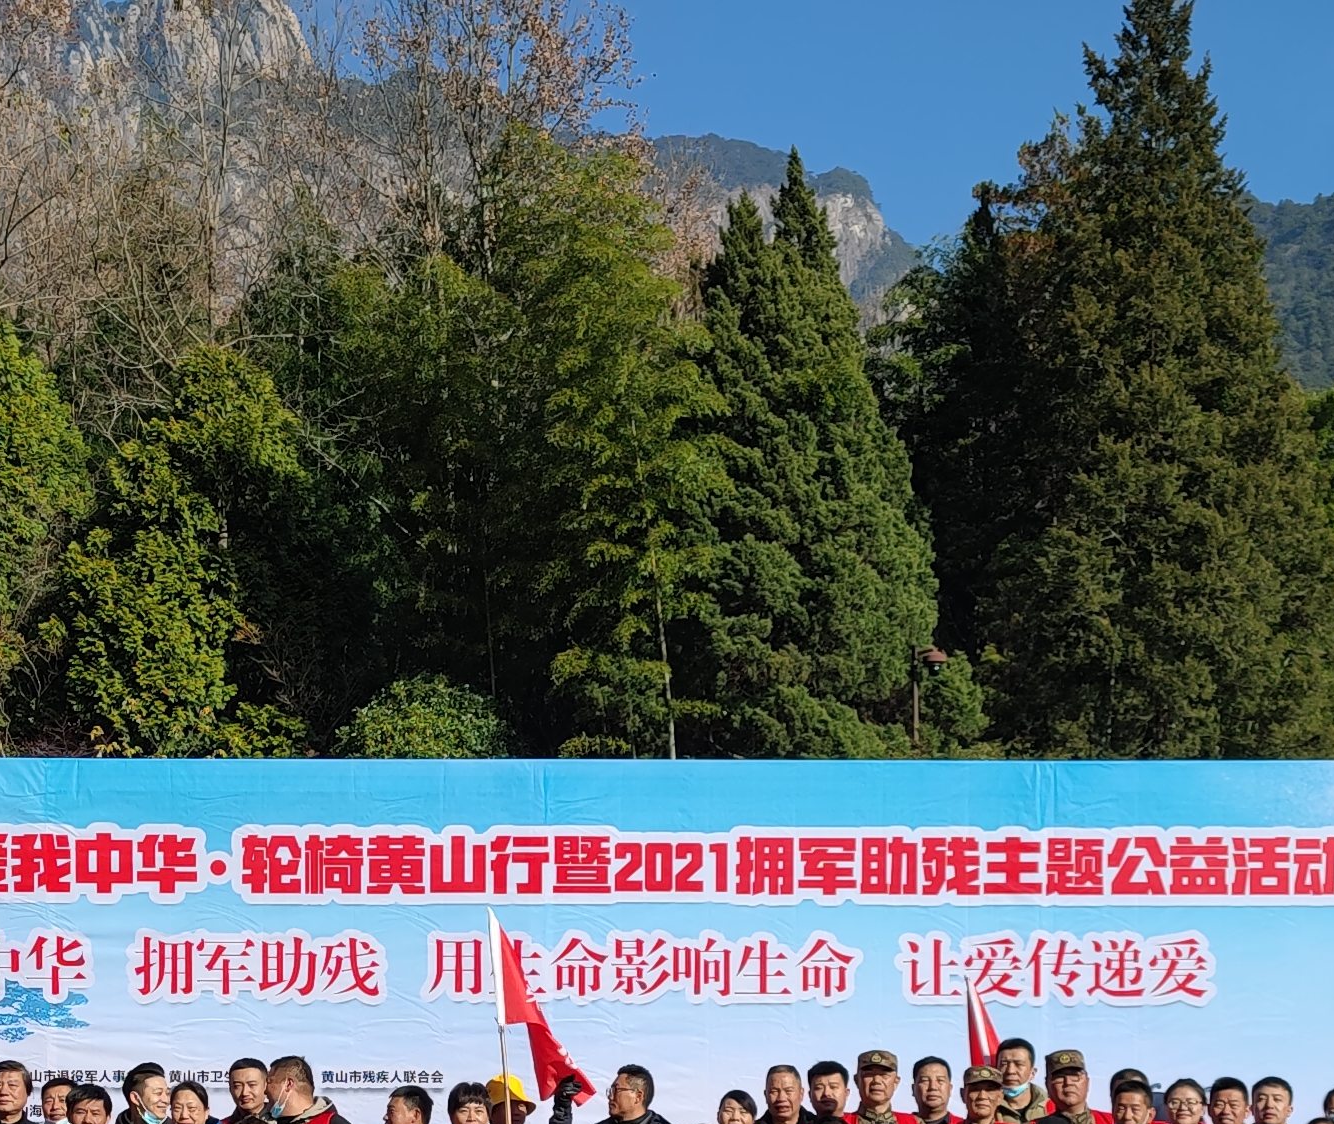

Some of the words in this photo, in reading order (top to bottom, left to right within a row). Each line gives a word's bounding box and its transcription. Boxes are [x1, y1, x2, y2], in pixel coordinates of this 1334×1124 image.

[134, 936, 380, 997] 拥军助残
[907, 937, 1211, 998] 让爱传递爱
[321, 1069, 445, 1084] 黄山市残疾人联合会
